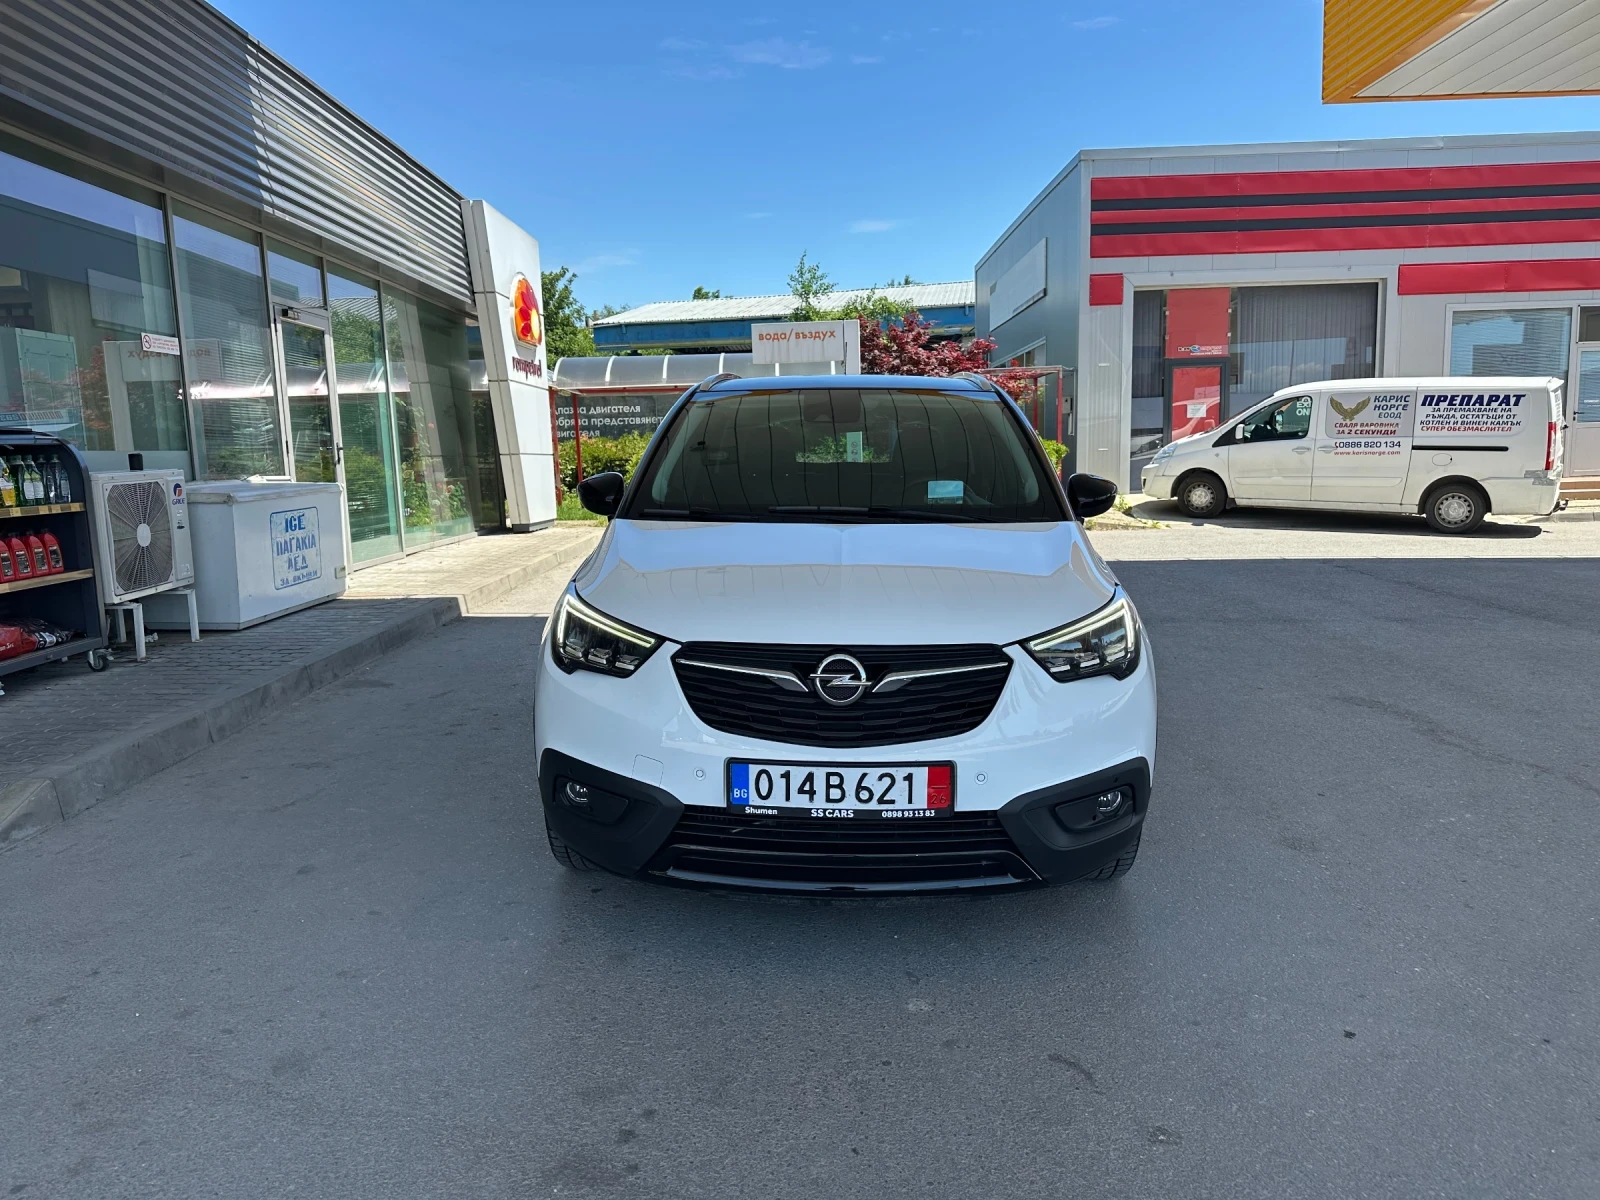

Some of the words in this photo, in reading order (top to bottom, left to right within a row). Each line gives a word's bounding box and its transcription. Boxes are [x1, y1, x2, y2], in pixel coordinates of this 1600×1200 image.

[1373, 395, 1411, 403] КАРИС
[1420, 394, 1527, 407] ПРЕПАРАТ
[588, 404, 641, 415] двигателя
[1338, 441, 1362, 449] 0886
[1383, 440, 1402, 448] 134
[284, 513, 306, 533] ICE
[733, 787, 748, 799] BG
[744, 806, 778, 815] Shumen
[810, 808, 824, 817] SS
[825, 808, 854, 818] CARS
[881, 810, 902, 818] 0898
[903, 810, 914, 818] 93
[914, 809, 924, 817] 13
[925, 809, 935, 817] 83
